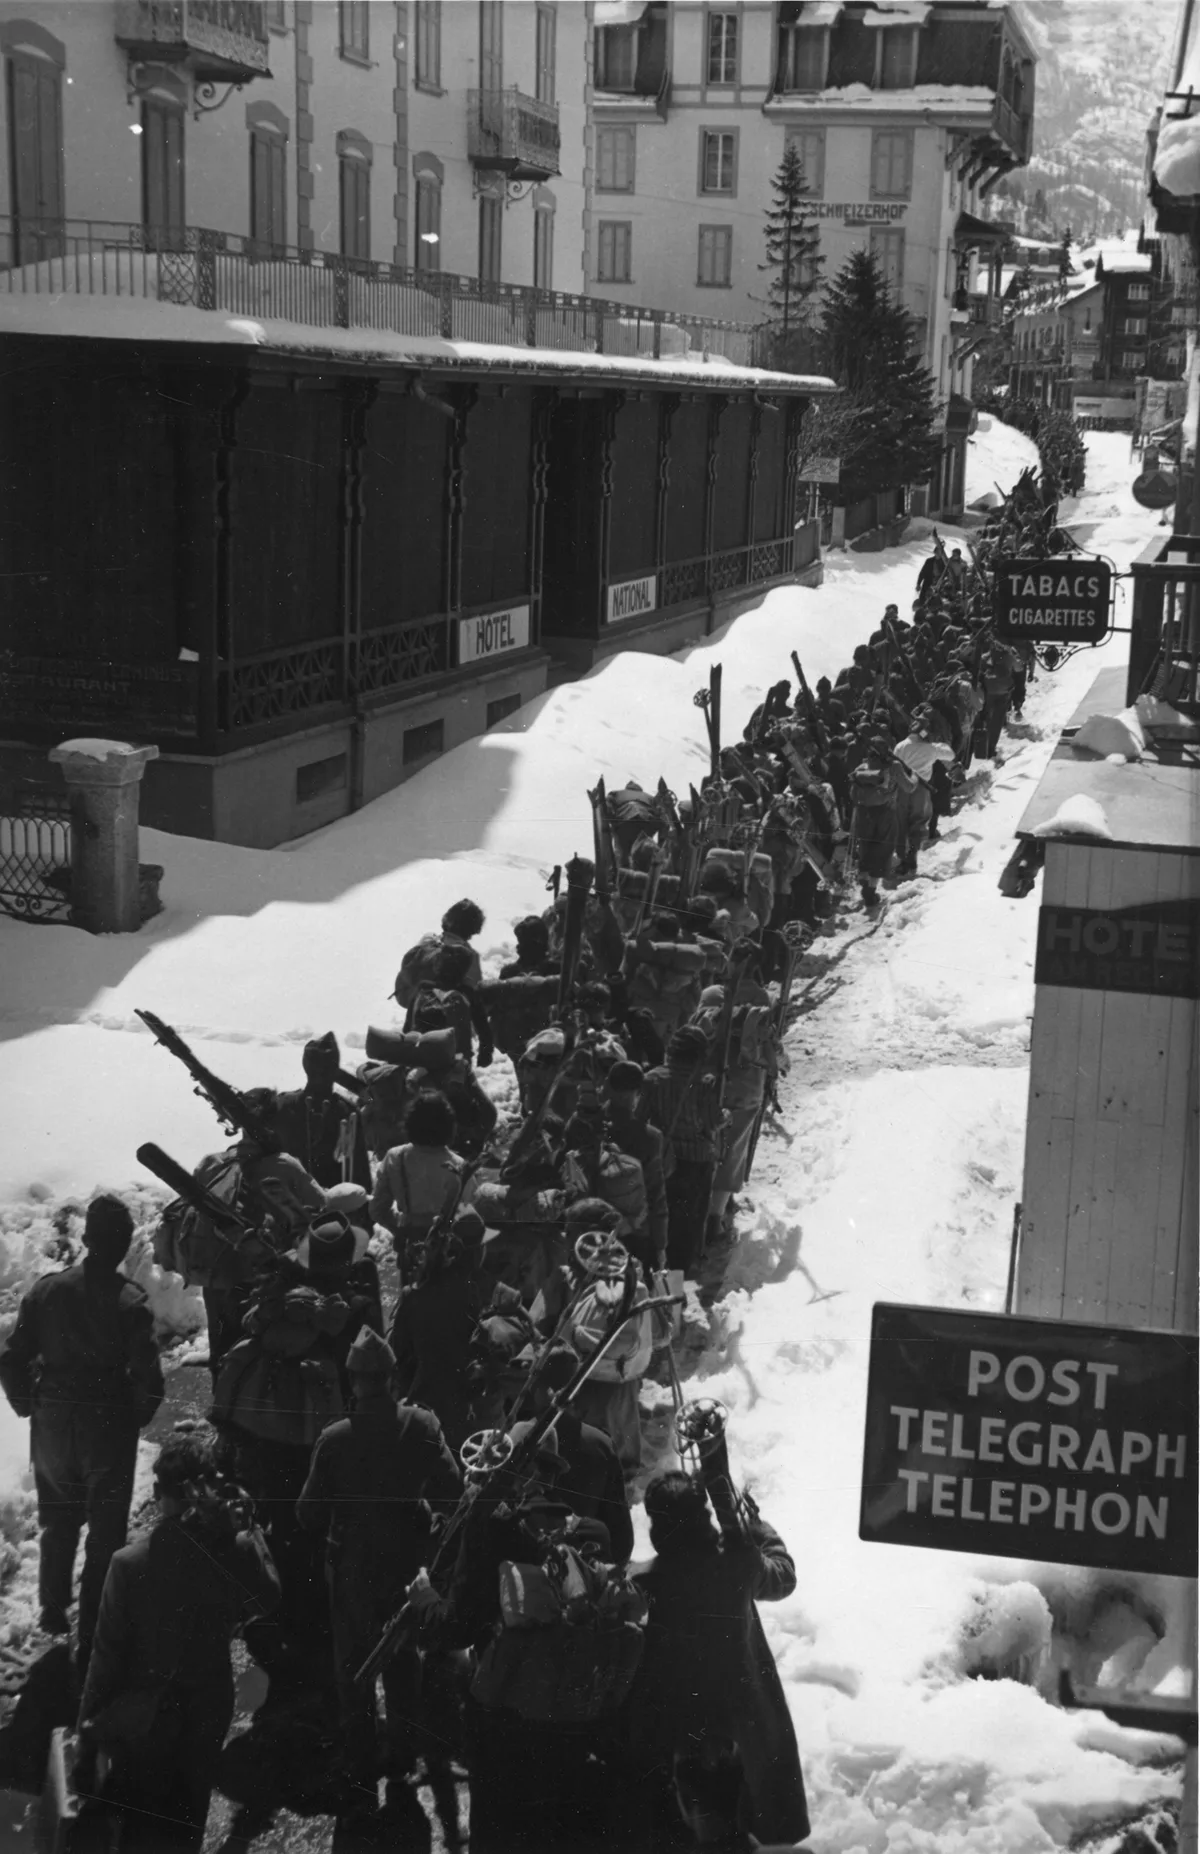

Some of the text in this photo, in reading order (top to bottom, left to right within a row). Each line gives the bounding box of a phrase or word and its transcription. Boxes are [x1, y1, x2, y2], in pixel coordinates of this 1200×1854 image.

[810, 202, 908, 219] SCHWEIZERHOF
[612, 579, 652, 618] NATIONAL
[1008, 574, 1099, 598] TABACS
[476, 613, 515, 655] HOTEL
[1009, 607, 1095, 626] CIGARETTES
[967, 1350, 1119, 1410] POST
[890, 1405, 1186, 1478] TELEGRAPH
[897, 1468, 1169, 1540] TELEPHON
